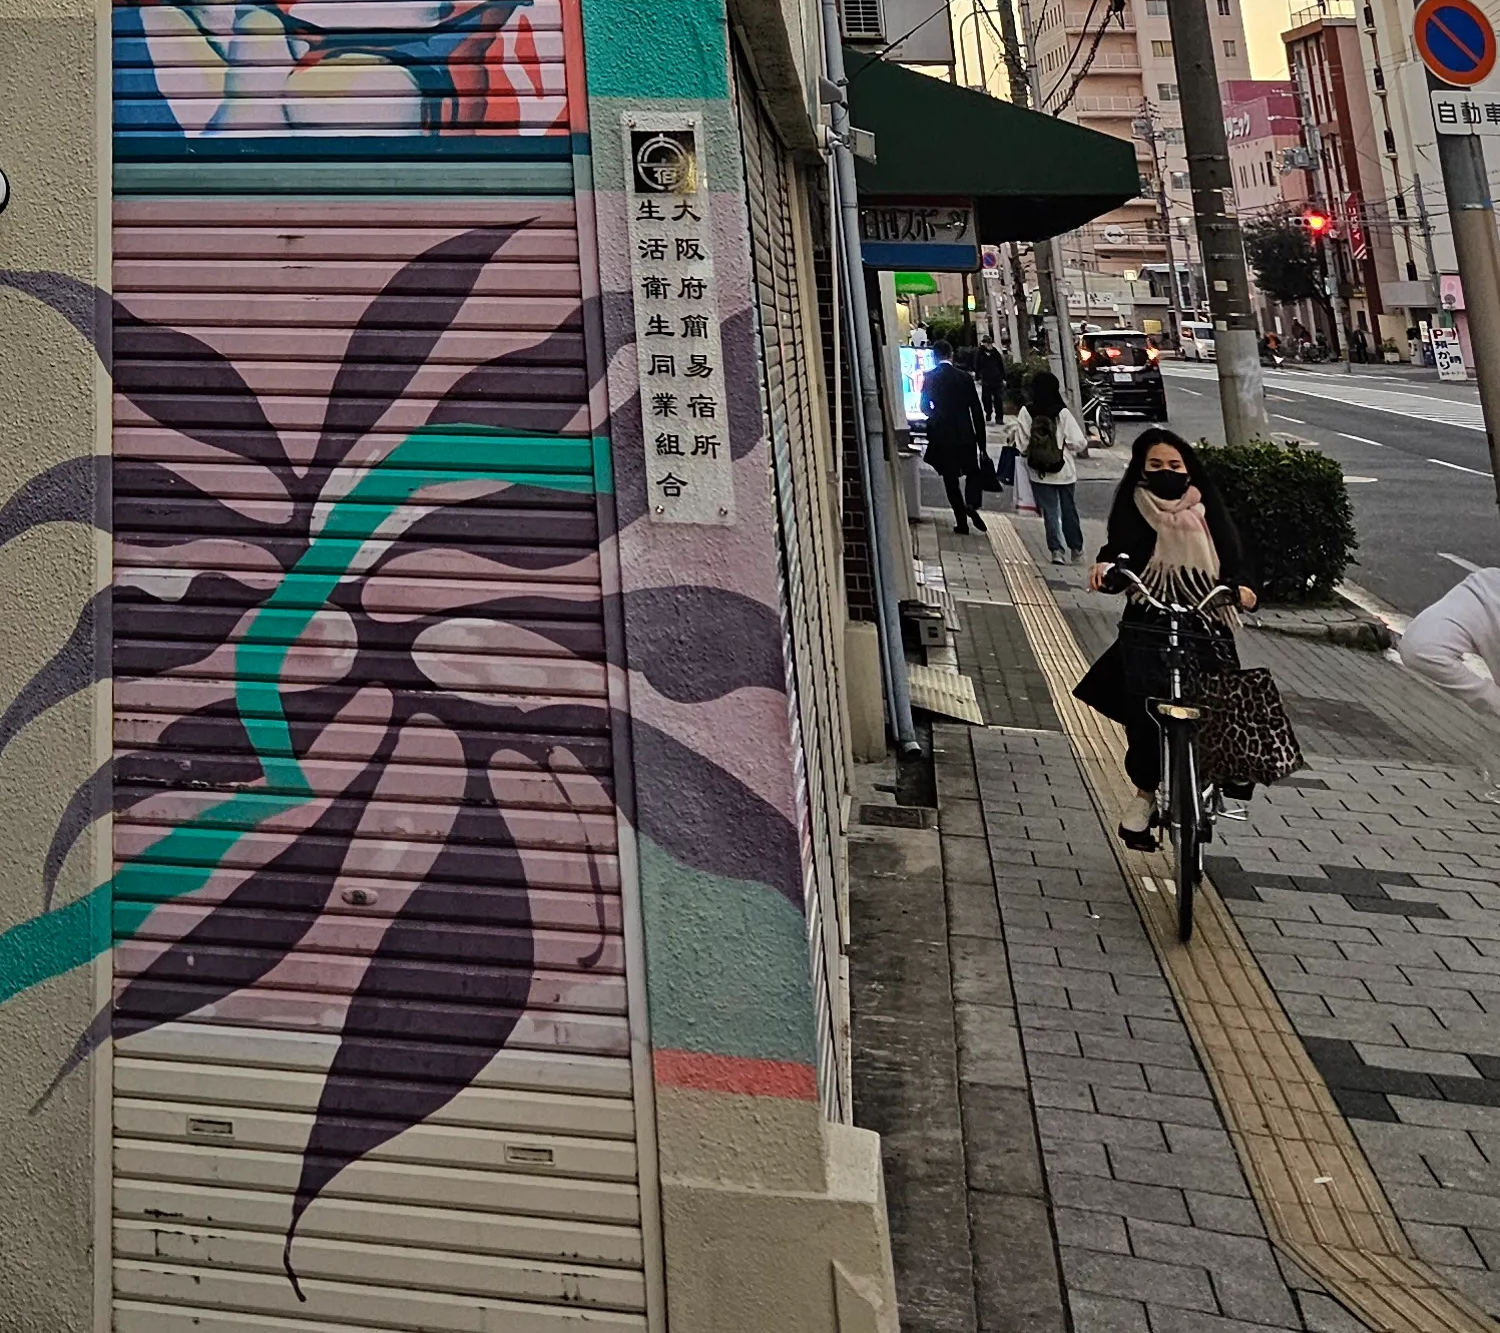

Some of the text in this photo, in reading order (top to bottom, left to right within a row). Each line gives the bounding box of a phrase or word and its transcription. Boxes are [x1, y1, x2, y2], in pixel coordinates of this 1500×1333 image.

[1437, 100, 1500, 125] 自動車
[635, 199, 688, 498] 生活衛生同業組合
[671, 199, 721, 460] 大阪府簡易宿所
